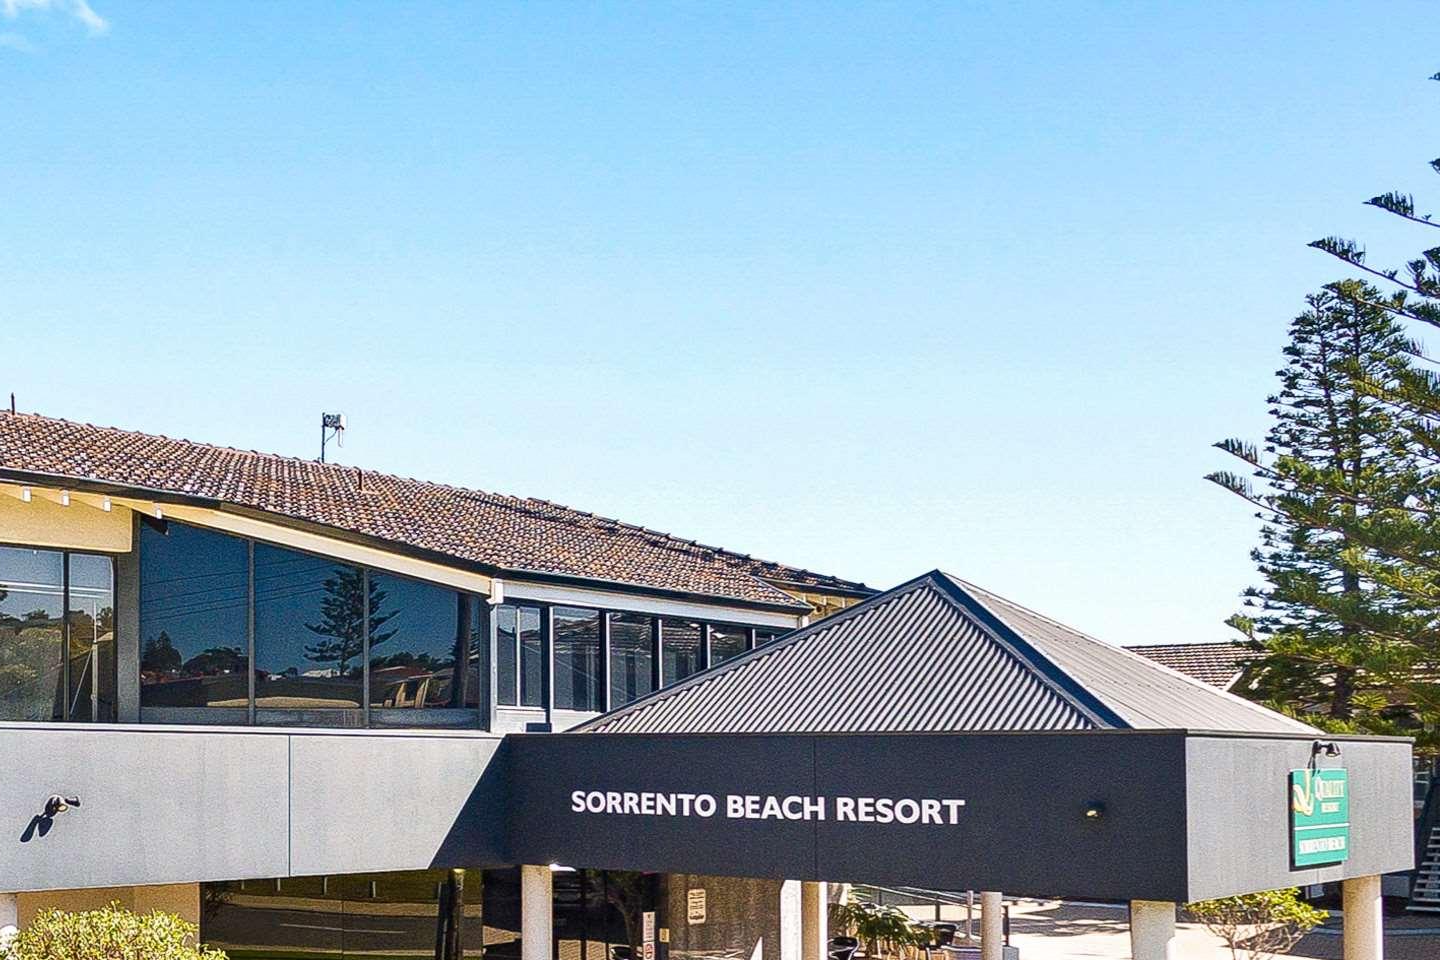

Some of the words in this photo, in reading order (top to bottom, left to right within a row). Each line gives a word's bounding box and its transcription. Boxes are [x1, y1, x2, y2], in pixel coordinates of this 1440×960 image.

[571, 790, 717, 818] SORRENTO
[726, 795, 825, 821] BEACH
[836, 797, 966, 825] RESORT
